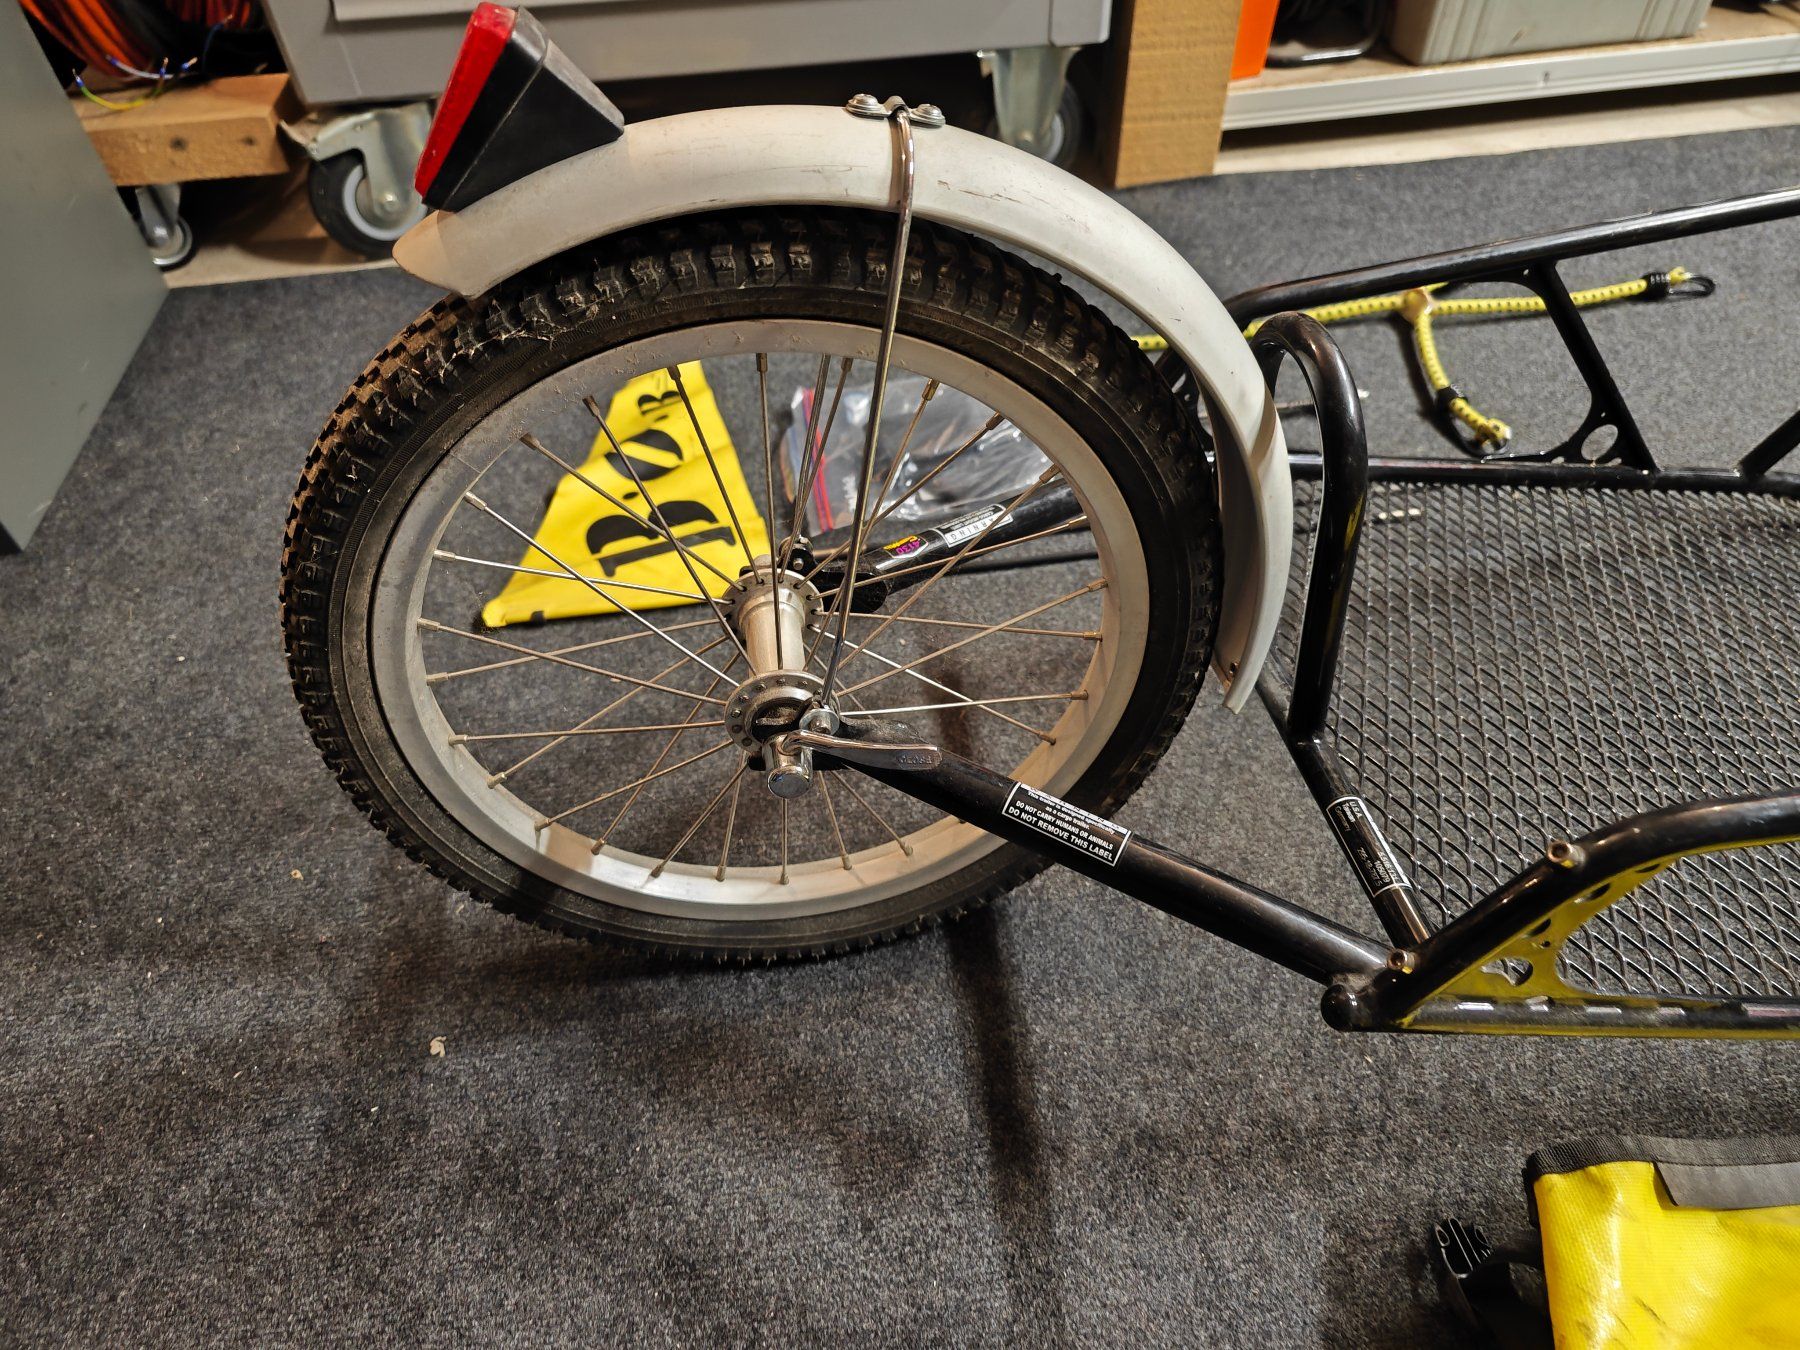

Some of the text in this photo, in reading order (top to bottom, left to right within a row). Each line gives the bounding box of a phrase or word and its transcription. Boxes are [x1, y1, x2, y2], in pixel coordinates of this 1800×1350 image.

[950, 514, 998, 540] ARNING
[896, 540, 921, 555] 4130
[1027, 790, 1038, 799] This
[1039, 795, 1055, 806] trailer
[1061, 806, 1085, 821] designed
[1335, 806, 1351, 832] Germany
[1008, 806, 1113, 861] DO NOT REMOVE THIS LABEL
[1016, 800, 1114, 850] DO NOT CARRY HUMANS OR ANIMALS
[1057, 811, 1072, 822] cargo
[1072, 818, 1090, 830] trailer.
[1342, 802, 1391, 883] Taiwan 105079
